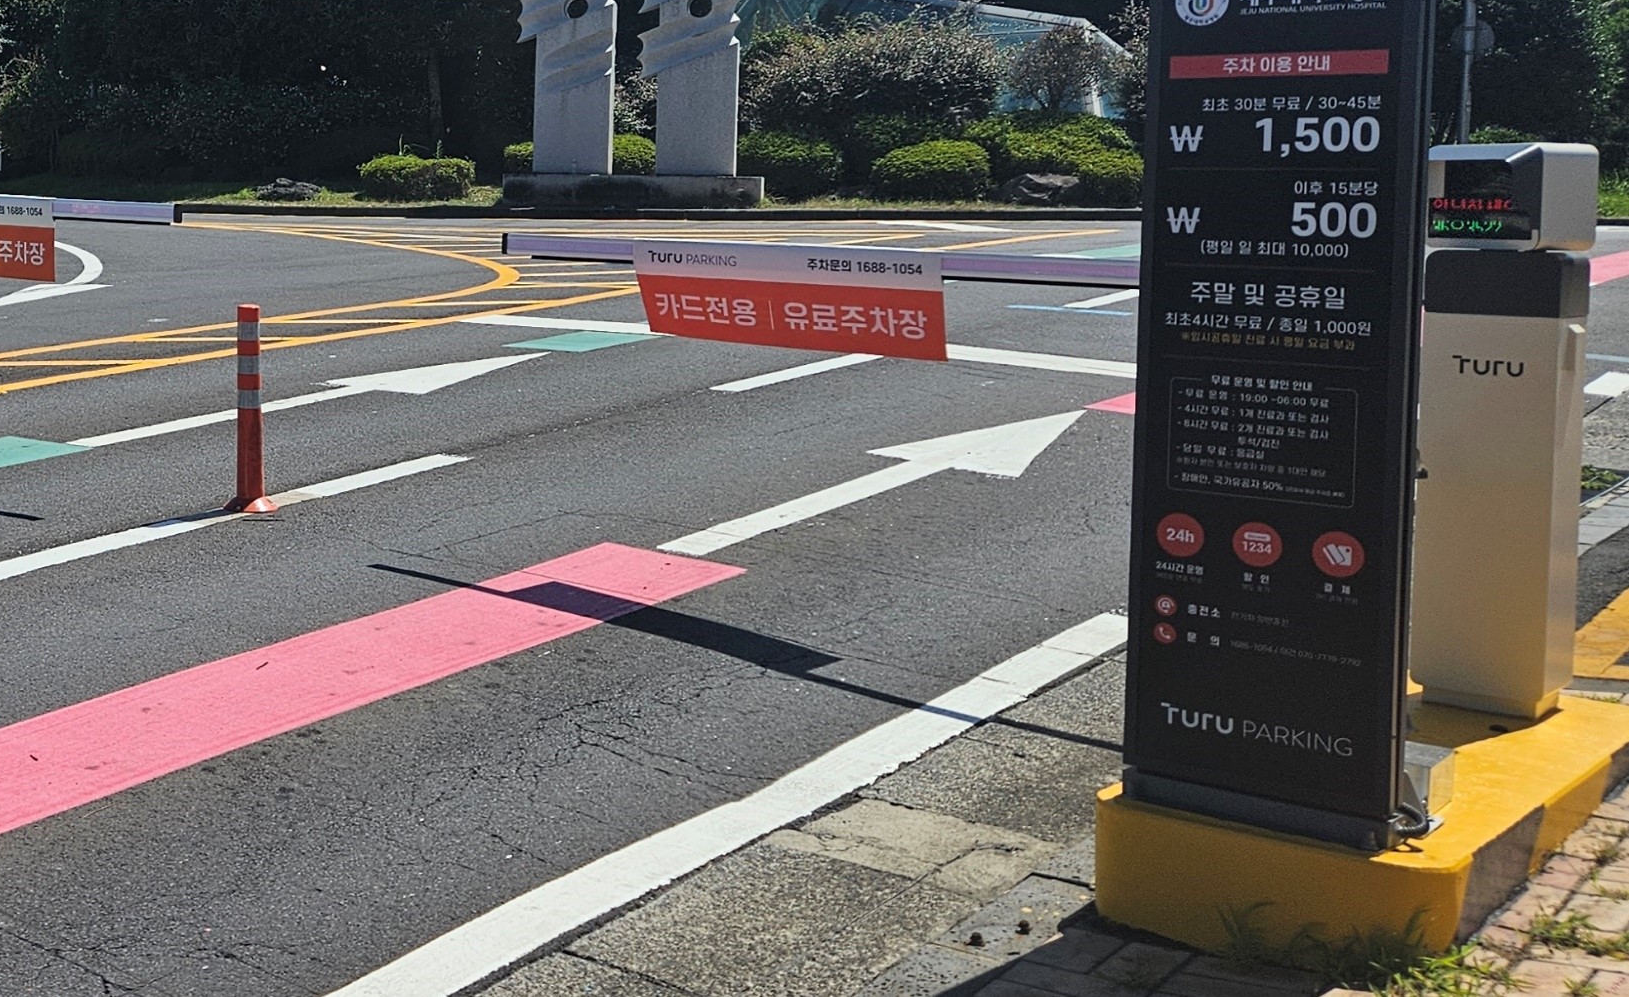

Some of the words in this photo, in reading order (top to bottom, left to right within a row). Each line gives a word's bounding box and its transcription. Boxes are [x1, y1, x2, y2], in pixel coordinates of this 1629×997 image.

[1240, 7, 1258, 16] JEJU
[1258, 5, 1298, 14] NATIONAL
[1299, 3, 1346, 13] UNIVERSITY
[1347, 1, 1387, 10] HOSPITAL
[1223, 56, 1256, 74] 주차
[1260, 55, 1292, 72] 이용
[1297, 54, 1331, 72] 안내
[1202, 98, 1229, 112] 최초
[1234, 97, 1267, 111] 30분
[1272, 96, 1301, 111] 무료
[1318, 95, 1382, 110] 30~45분
[1255, 116, 1381, 158] 1,500
[1294, 181, 1323, 196] 이후
[1329, 181, 1378, 196] 15분당
[7, 205, 43, 217] 1688-1054
[1291, 201, 1378, 239] 500
[1200, 239, 1234, 255] (평일
[1238, 240, 1251, 255] 일
[1258, 241, 1286, 256] 최대
[686, 253, 737, 267] PARKING
[807, 257, 852, 273] 주차문의
[856, 261, 923, 276] 1688-1054
[1190, 281, 1236, 305] 주말
[1244, 283, 1266, 307] 및
[1274, 285, 1346, 310] 공휴일
[655, 292, 758, 327] 카드전용
[783, 301, 927, 341] 유료주차장
[1165, 311, 1229, 329] 최초4시간
[1234, 315, 1261, 330] 무료
[1279, 317, 1308, 333] 종일
[1314, 319, 1372, 336] 1,000원
[1166, 527, 1195, 543] 24h
[1241, 540, 1272, 554] 1234
[1242, 719, 1354, 757] PARKING
